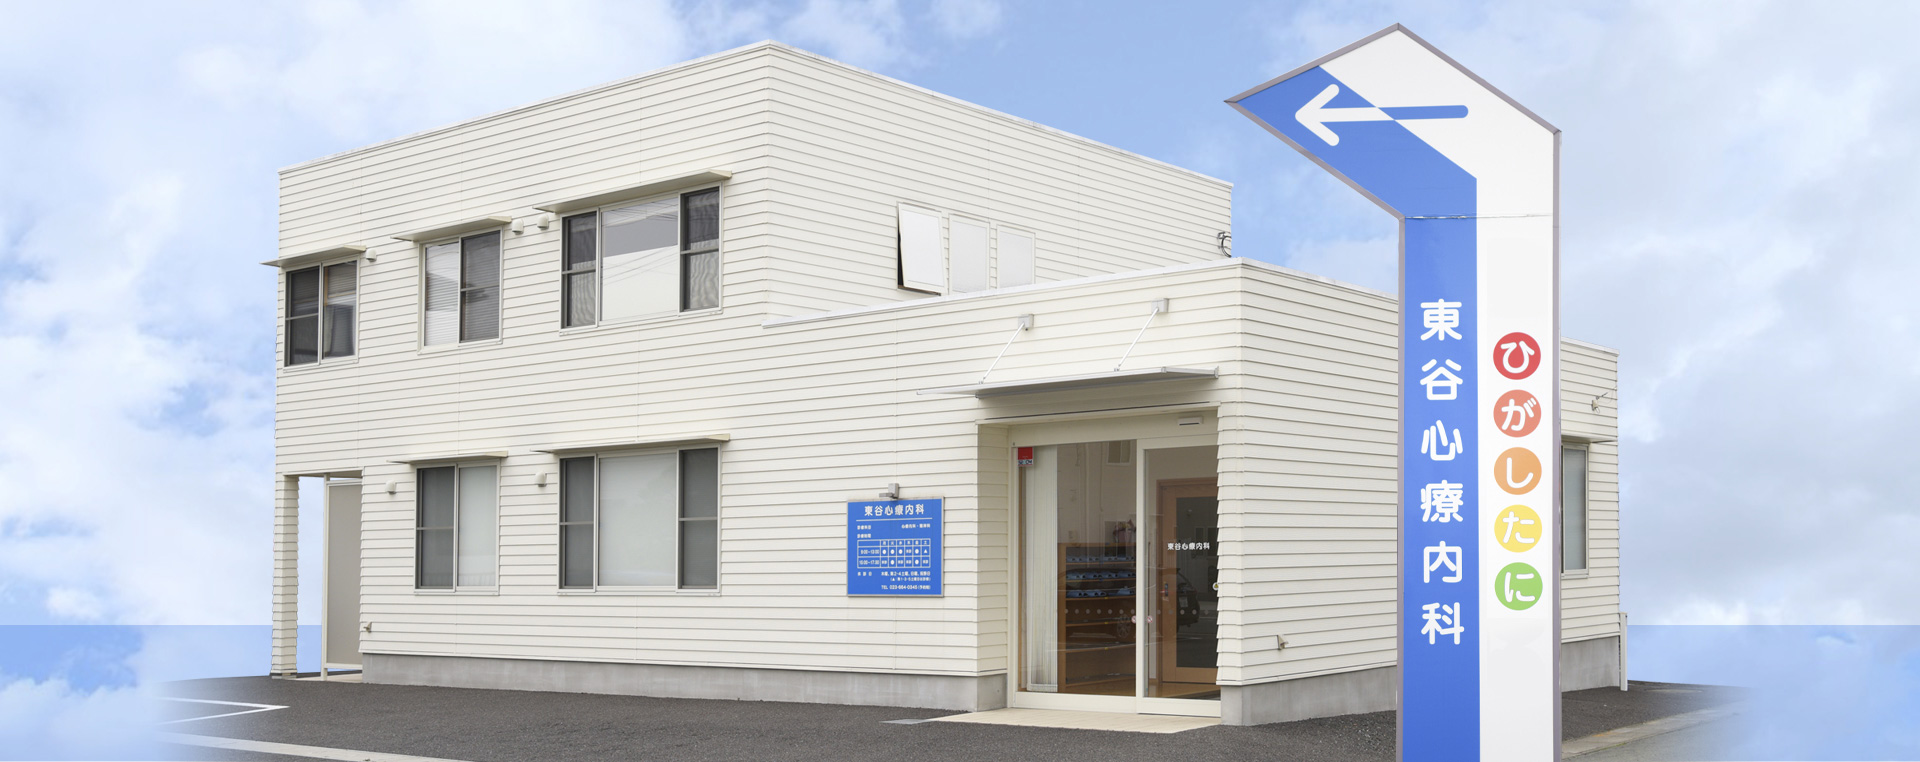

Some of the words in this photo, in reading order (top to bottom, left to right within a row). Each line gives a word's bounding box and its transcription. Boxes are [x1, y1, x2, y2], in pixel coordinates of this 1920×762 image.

[864, 504, 924, 516] 東谷心療内科
[1420, 298, 1464, 645] 東谷心療内科
[1500, 340, 1538, 603] ひがしたに
[1167, 541, 1210, 551] 東谷心療内科
